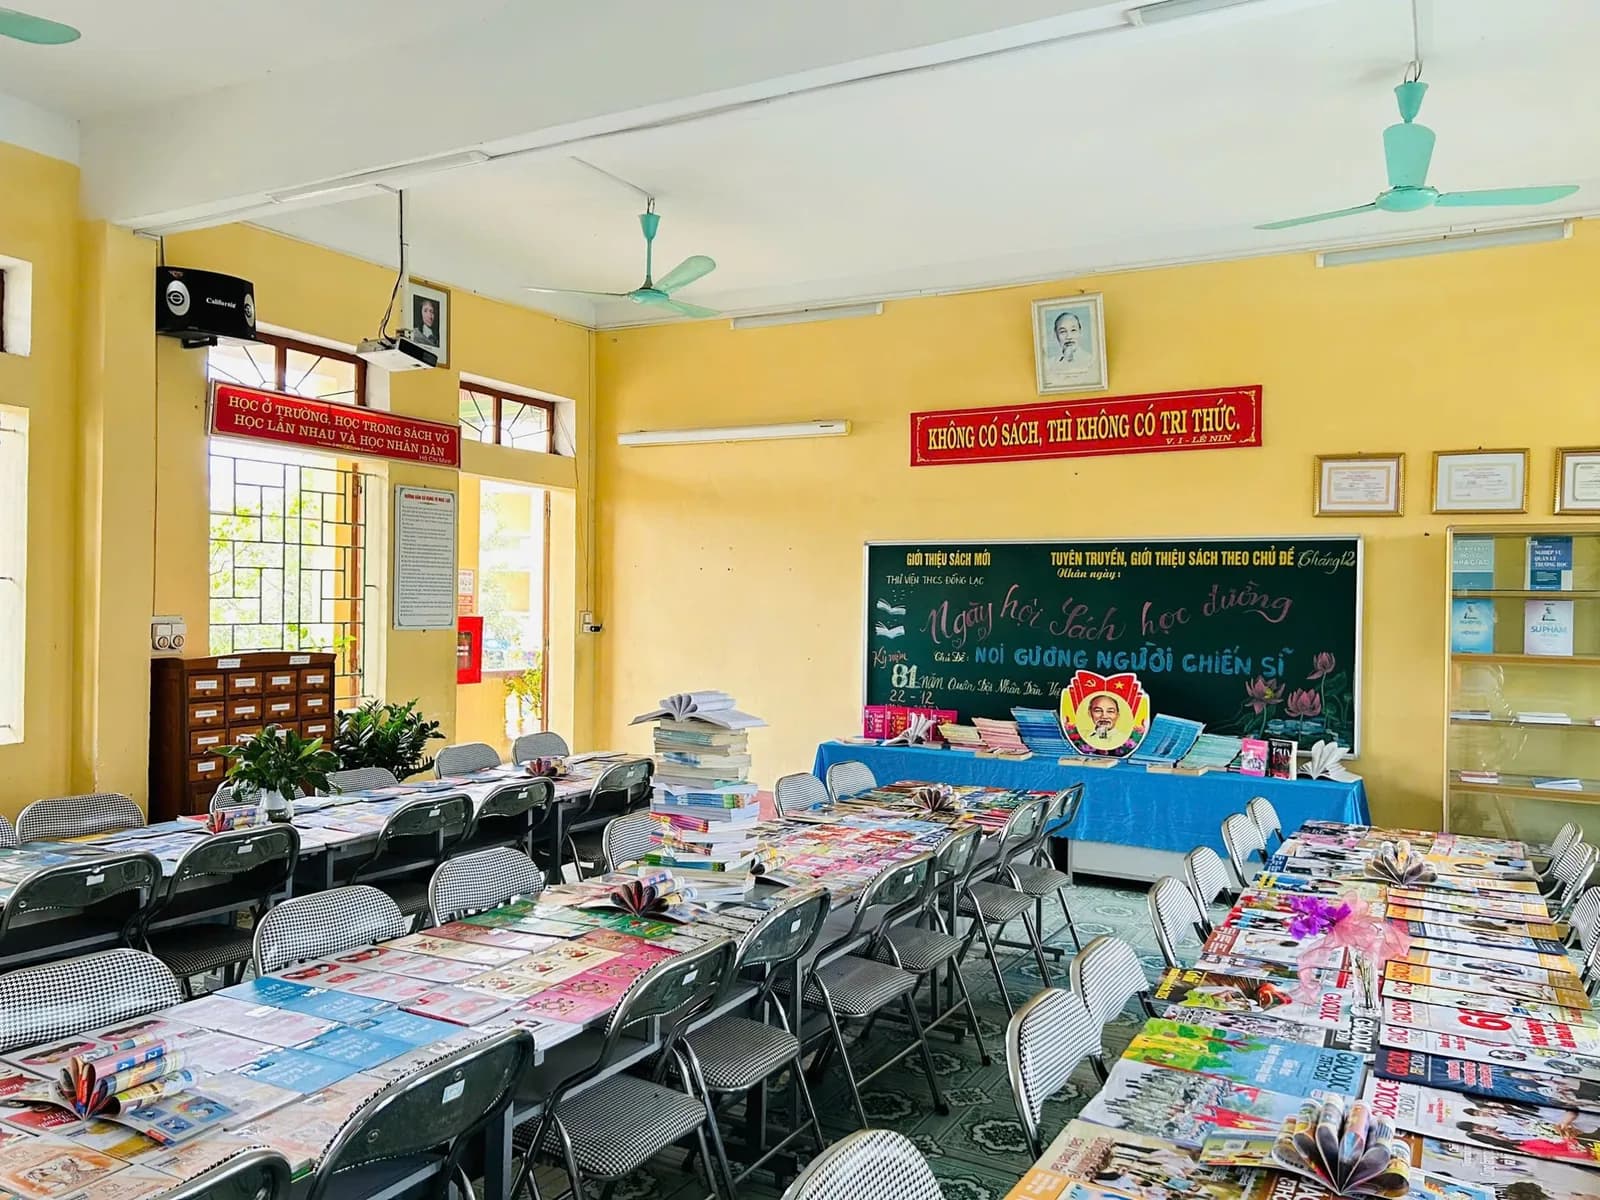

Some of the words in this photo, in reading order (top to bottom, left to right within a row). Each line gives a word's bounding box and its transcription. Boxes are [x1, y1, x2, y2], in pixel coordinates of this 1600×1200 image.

[206, 297, 236, 308] California
[228, 395, 259, 412] HỌC
[262, 398, 272, 414] Ở
[334, 416, 360, 430] HỌC
[362, 420, 401, 436] TRONG
[404, 426, 432, 441] SÁCH
[928, 420, 975, 450] KHÔNG
[978, 418, 998, 447] CÓ
[1001, 414, 1043, 448] SÁCH,
[1048, 410, 1072, 444] THÌ
[1076, 408, 1130, 442] KHÔNG
[1134, 404, 1156, 436] CÓ
[1160, 410, 1188, 434] TRI
[1192, 398, 1240, 433] THỨC.
[234, 415, 264, 431] HỌC
[300, 426, 336, 441] NHAU
[340, 430, 356, 444] VÀ
[360, 435, 385, 450] HỌC
[386, 439, 419, 454] NHÂN
[422, 443, 444, 456] DÂN
[1209, 434, 1232, 442] NIN
[906, 548, 923, 566] GIỚI
[924, 550, 948, 568] THIỆU
[948, 549, 972, 566] SÁCH
[974, 548, 991, 566] MỚI
[1050, 549, 1083, 566] TUYÊN
[1131, 546, 1152, 566] GIỚI
[1155, 548, 1186, 568] THIỆU
[1188, 547, 1216, 566] SÁCH
[1220, 551, 1250, 566] THEO
[1252, 545, 1276, 566] CHỦ
[904, 572, 920, 586] VIỆN
[922, 576, 943, 584] THCS
[969, 576, 985, 587] LẠC
[1057, 568, 1088, 578] Nhân
[1141, 601, 1191, 636] học
[891, 664, 918, 688] 81
[889, 690, 906, 702] 22
[920, 690, 935, 704] 12
